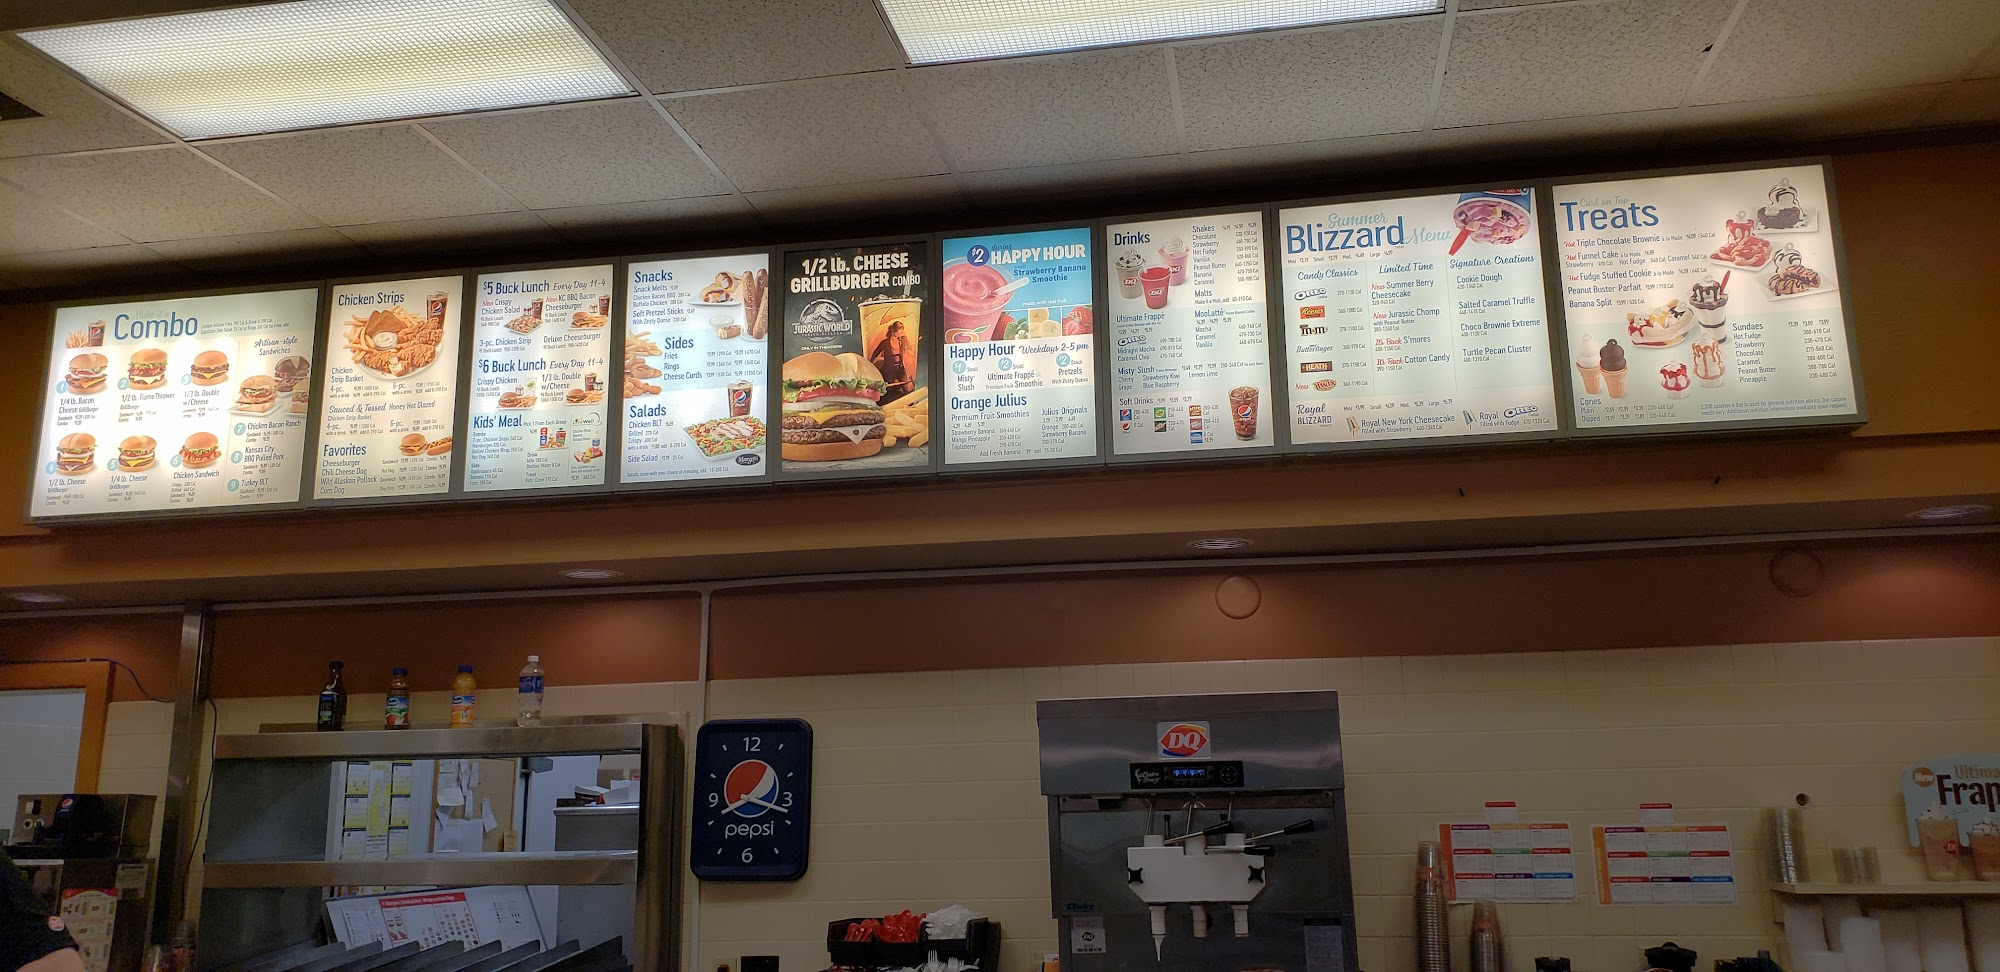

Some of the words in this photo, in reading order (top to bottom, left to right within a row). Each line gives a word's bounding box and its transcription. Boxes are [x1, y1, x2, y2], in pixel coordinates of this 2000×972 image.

[1580, 199, 1599, 207] Curl
[1614, 196, 1628, 204] Top
[1328, 213, 1389, 228] Summer
[1560, 202, 1659, 231] Treats
[1193, 225, 1214, 233] Shakes
[1286, 216, 1404, 254] Blizzard
[1404, 227, 1452, 244] Menu
[1114, 232, 1150, 246] Drinks
[1576, 239, 1595, 248] Triple
[1597, 236, 1631, 245] Chocolate
[1633, 234, 1660, 244] Brownie
[971, 247, 984, 263] $2
[991, 248, 1042, 265] HAPPY
[1044, 244, 1086, 260] HOUR
[1578, 251, 1600, 260] Funnel
[1602, 251, 1618, 259] Cake
[802, 258, 827, 276] 1/2
[831, 257, 850, 273] lb.
[854, 253, 908, 271] CHEESE
[1379, 263, 1411, 274] Limited
[1413, 262, 1434, 271] Time
[1450, 258, 1492, 270] Signature
[1494, 254, 1535, 265] Creations
[1014, 266, 1056, 276] Strawberry
[1058, 264, 1086, 272] Banana
[1298, 270, 1324, 281] Candy
[1326, 268, 1359, 278] Classics
[1580, 273, 1600, 282] Fudge
[1602, 271, 1627, 280] Stuffed
[1629, 270, 1652, 278] Cookie
[635, 270, 672, 283] Snacks
[791, 272, 889, 293] GRILLBURGER
[893, 275, 920, 287] COMBO
[1032, 275, 1068, 283] Smoothie
[1481, 273, 1502, 282] Dough
[483, 281, 493, 295] $5
[496, 282, 518, 294] Buck
[522, 280, 549, 293] Lunch
[553, 283, 572, 291] Every
[574, 281, 587, 290] Day
[590, 279, 606, 288] 11-4
[1195, 289, 1212, 297] Malts
[338, 294, 374, 306] Chicken
[377, 291, 404, 306] Strips
[558, 294, 566, 302] KC
[1294, 288, 1327, 301] OREO
[546, 302, 582, 311] Cheeseburger
[1459, 300, 1480, 309] Salted
[1482, 298, 1510, 307] Caramel
[1512, 296, 1535, 305] Truffle
[1569, 300, 1594, 308] Banana
[1597, 298, 1612, 307] Split
[633, 310, 644, 318] Soft
[646, 309, 665, 317] Pretzel
[1117, 314, 1142, 323] Ultimate
[1144, 312, 1165, 321] Frappé
[1195, 308, 1224, 317] MooLatté
[114, 312, 197, 340] Combo
[792, 322, 823, 335] JURASSIC
[824, 320, 852, 335] WORLD
[1461, 323, 1482, 331] Choco
[1484, 320, 1510, 330] Brownie
[1512, 319, 1540, 328] Extreme
[1732, 322, 1764, 331] Sundaes
[255, 336, 298, 347] Artisan-style
[665, 337, 694, 350] Sides
[259, 347, 290, 356] Sandwiches
[950, 345, 985, 361] Happy
[989, 344, 1015, 356] Hour
[1019, 345, 1059, 354] Weekdays
[1061, 343, 1075, 351] 2-5
[1076, 344, 1089, 352] pm
[1405, 355, 1427, 364] Cotton
[1429, 354, 1450, 363] Candy
[478, 359, 489, 373] $6
[492, 360, 515, 372] Buck
[518, 358, 546, 371] Lunch
[1118, 367, 1134, 375] Misty
[1137, 366, 1155, 374] Slush
[664, 373, 684, 381] Cheese
[686, 371, 702, 379] Curds
[329, 405, 354, 414] Sauced
[356, 404, 363, 413] &
[365, 403, 386, 411] Tossed
[389, 403, 405, 411] Honey
[418, 400, 435, 408] Glazed
[951, 396, 991, 412] Orange
[995, 393, 1027, 407] Julius
[1119, 398, 1133, 406] Soft
[1134, 397, 1153, 405] Drinks
[1580, 398, 1602, 406] Cones
[630, 404, 666, 418] Salads
[1297, 403, 1326, 415] Royal
[474, 416, 496, 428] Kids'
[498, 415, 522, 428] Meal
[952, 413, 978, 421] Premium
[981, 412, 994, 420] Fruit
[997, 410, 1030, 419] Smoothies
[1298, 416, 1332, 425] BLIZZARD
[248, 422, 267, 430] Chicken
[324, 443, 366, 456] Favorites
[628, 455, 640, 463] Side
[642, 454, 658, 462] Salad
[174, 471, 193, 479] Chicken
[195, 470, 219, 478] Sandwich
[334, 477, 355, 485] Alaskan
[357, 476, 377, 484] Pollock
[242, 479, 258, 487] Turkey
[260, 478, 268, 486] BLT
[743, 737, 761, 751] 12
[1168, 732, 1200, 750] DQ
[1915, 773, 1933, 782] New
[709, 793, 718, 807] 9
[782, 792, 793, 807] 3
[725, 821, 774, 839] pepsi
[742, 848, 753, 863] 6
